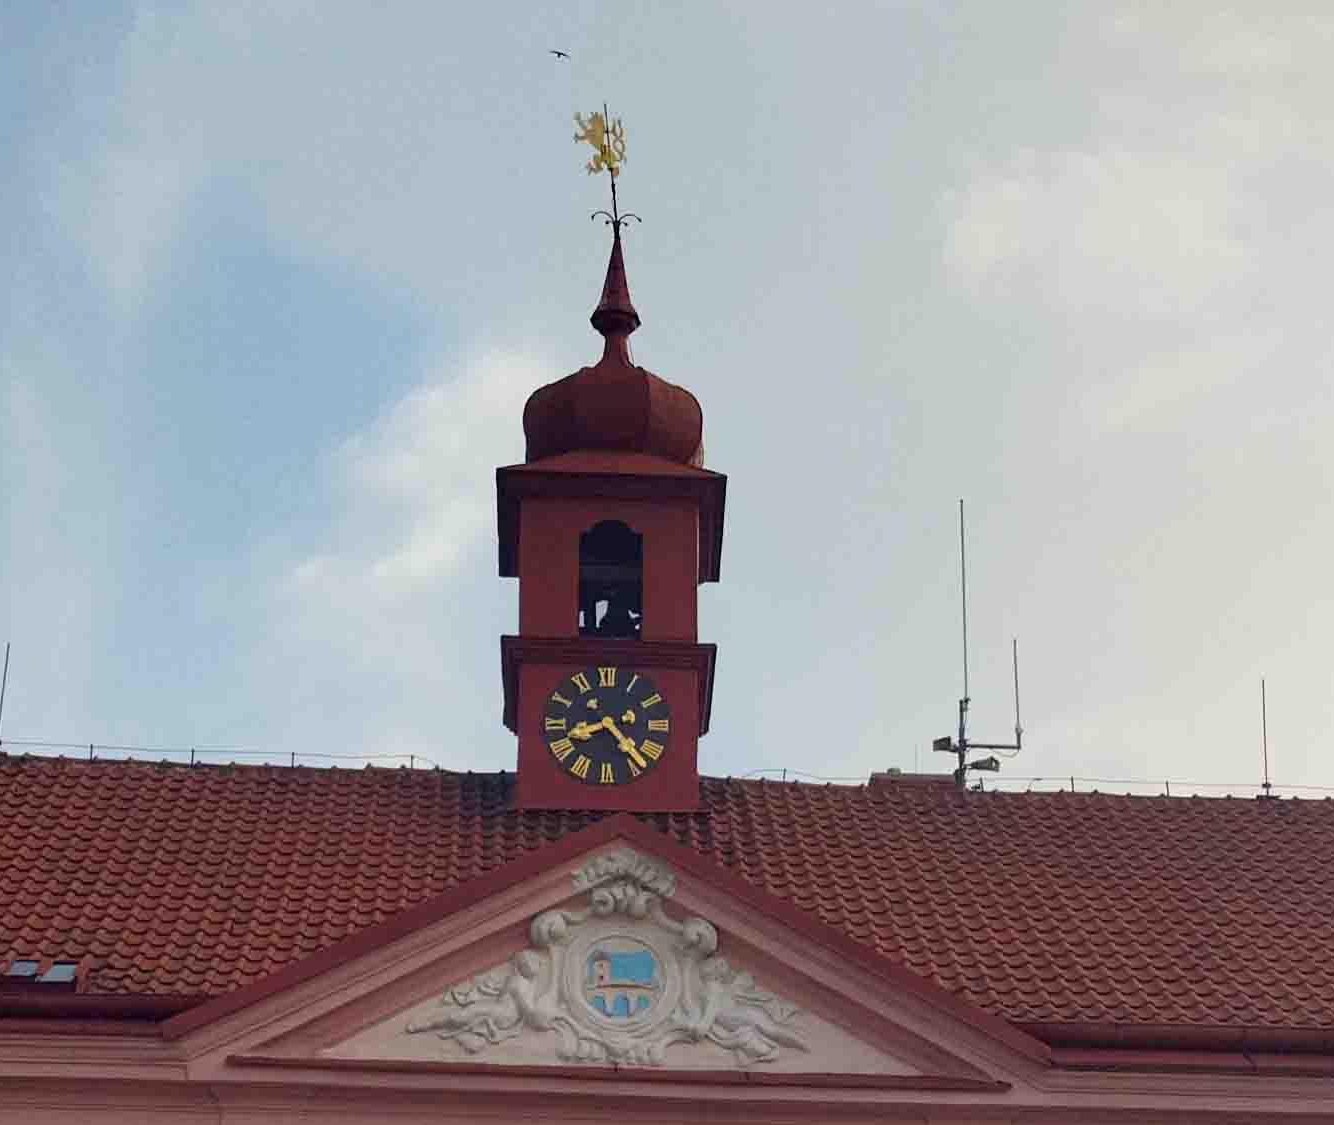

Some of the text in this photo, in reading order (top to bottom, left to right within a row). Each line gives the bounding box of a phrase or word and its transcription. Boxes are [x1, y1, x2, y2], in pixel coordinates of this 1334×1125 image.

[571, 672, 592, 694] XI
[597, 667, 617, 688] XII
[626, 674, 640, 692] I
[599, 763, 615, 784] VI
